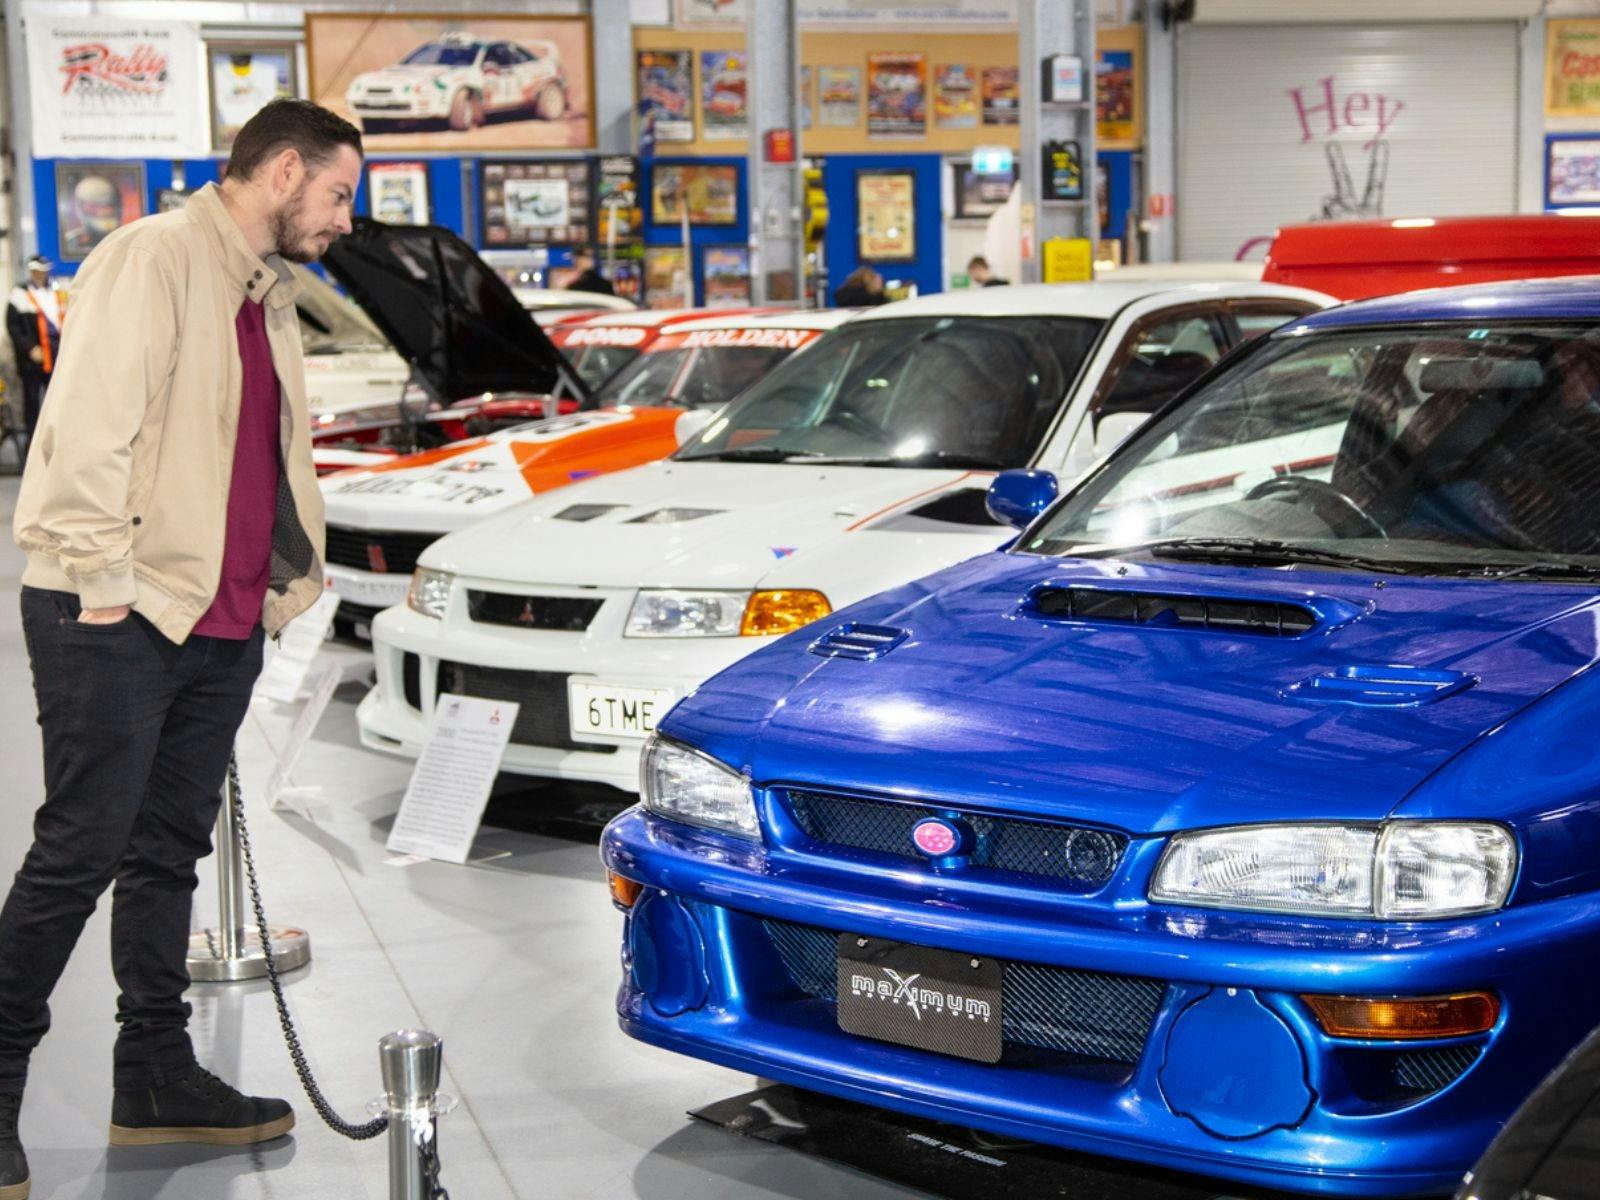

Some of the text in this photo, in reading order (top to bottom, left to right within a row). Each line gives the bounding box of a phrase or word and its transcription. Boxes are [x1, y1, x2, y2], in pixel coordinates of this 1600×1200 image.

[1286, 75, 1406, 152] Hey
[564, 328, 647, 346] BOND
[681, 329, 809, 349] HOLDEN
[588, 697, 655, 732] 6TME
